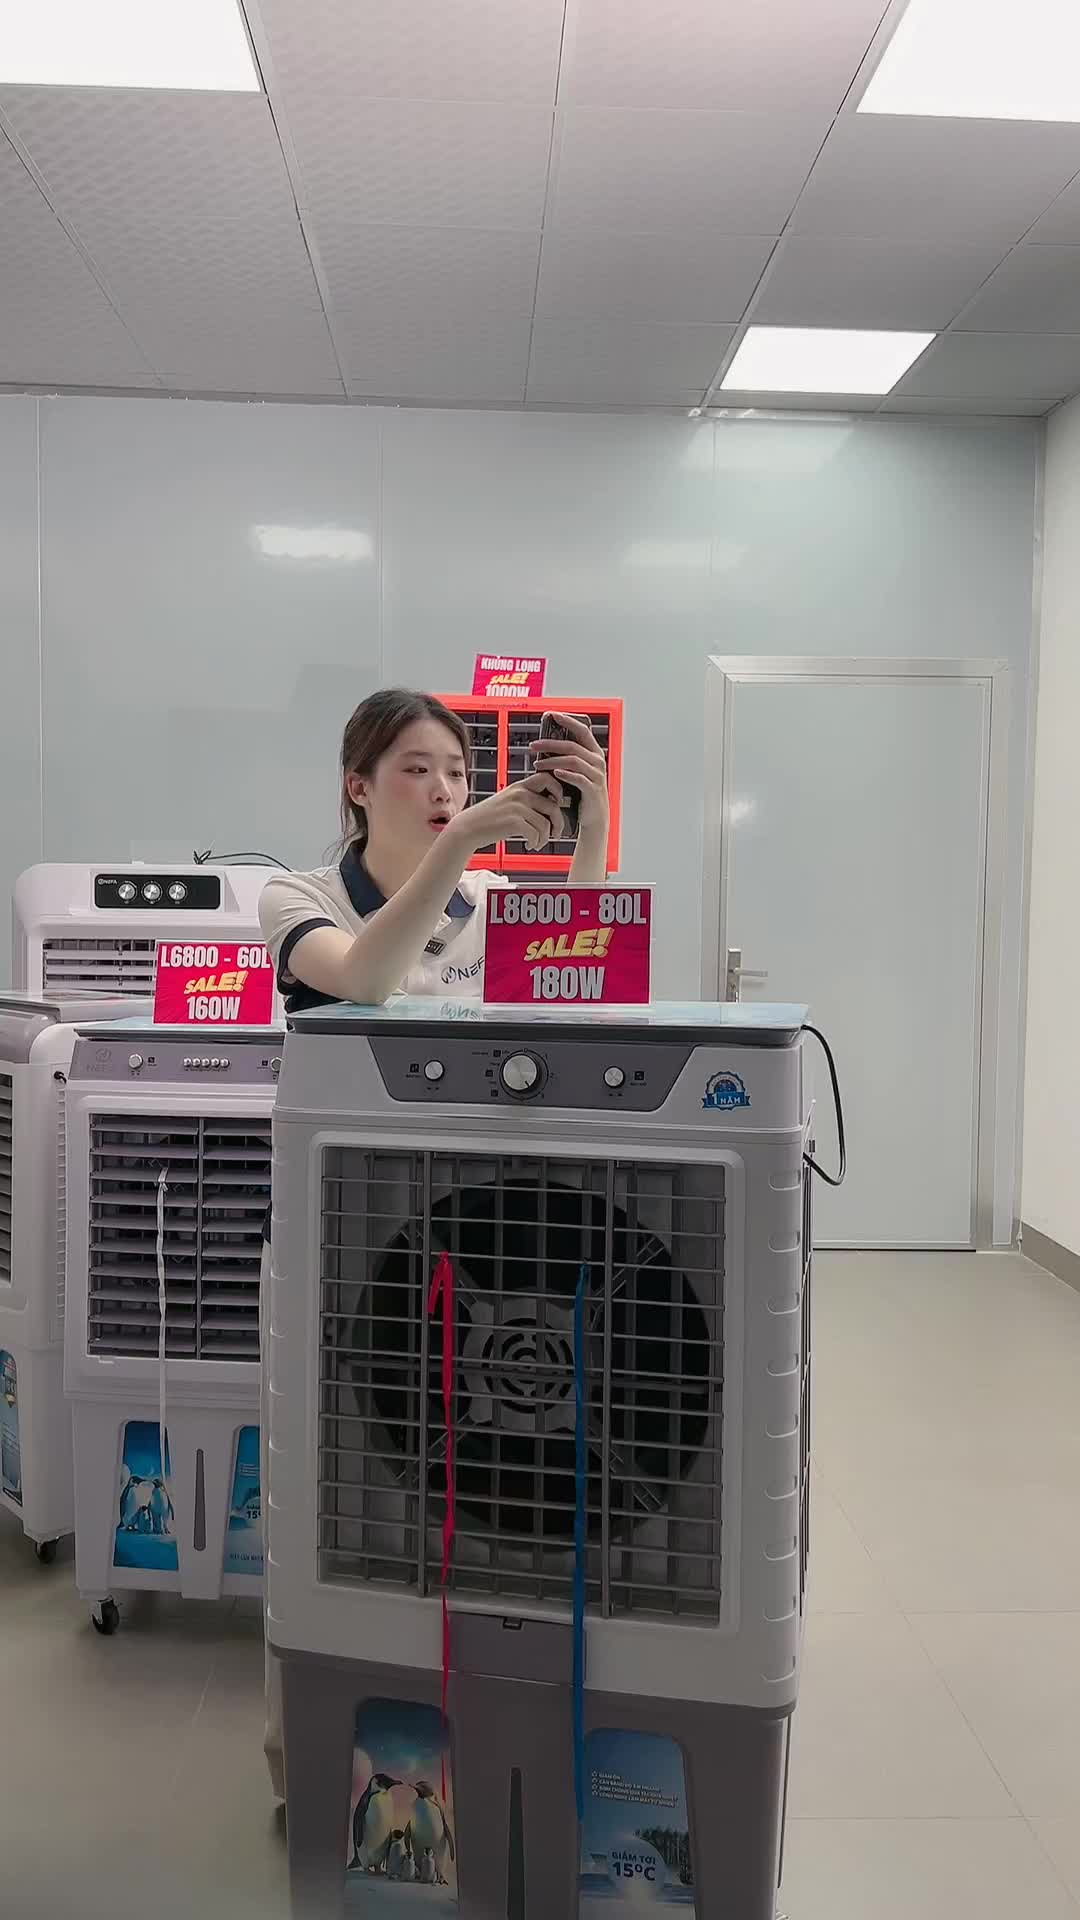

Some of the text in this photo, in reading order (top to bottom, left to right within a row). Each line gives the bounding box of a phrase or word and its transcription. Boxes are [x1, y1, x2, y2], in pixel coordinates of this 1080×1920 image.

[515, 659, 541, 672] LONG
[485, 684, 530, 697] 1000W
[489, 672, 530, 685] SALE!
[490, 893, 571, 925] L8600
[598, 893, 646, 925] 80L
[523, 927, 613, 961] SALE!
[160, 945, 219, 969] L6800
[236, 946, 271, 969] 60L
[184, 970, 248, 995] SALE!
[529, 966, 605, 1001] 180W
[186, 996, 241, 1021] 160W
